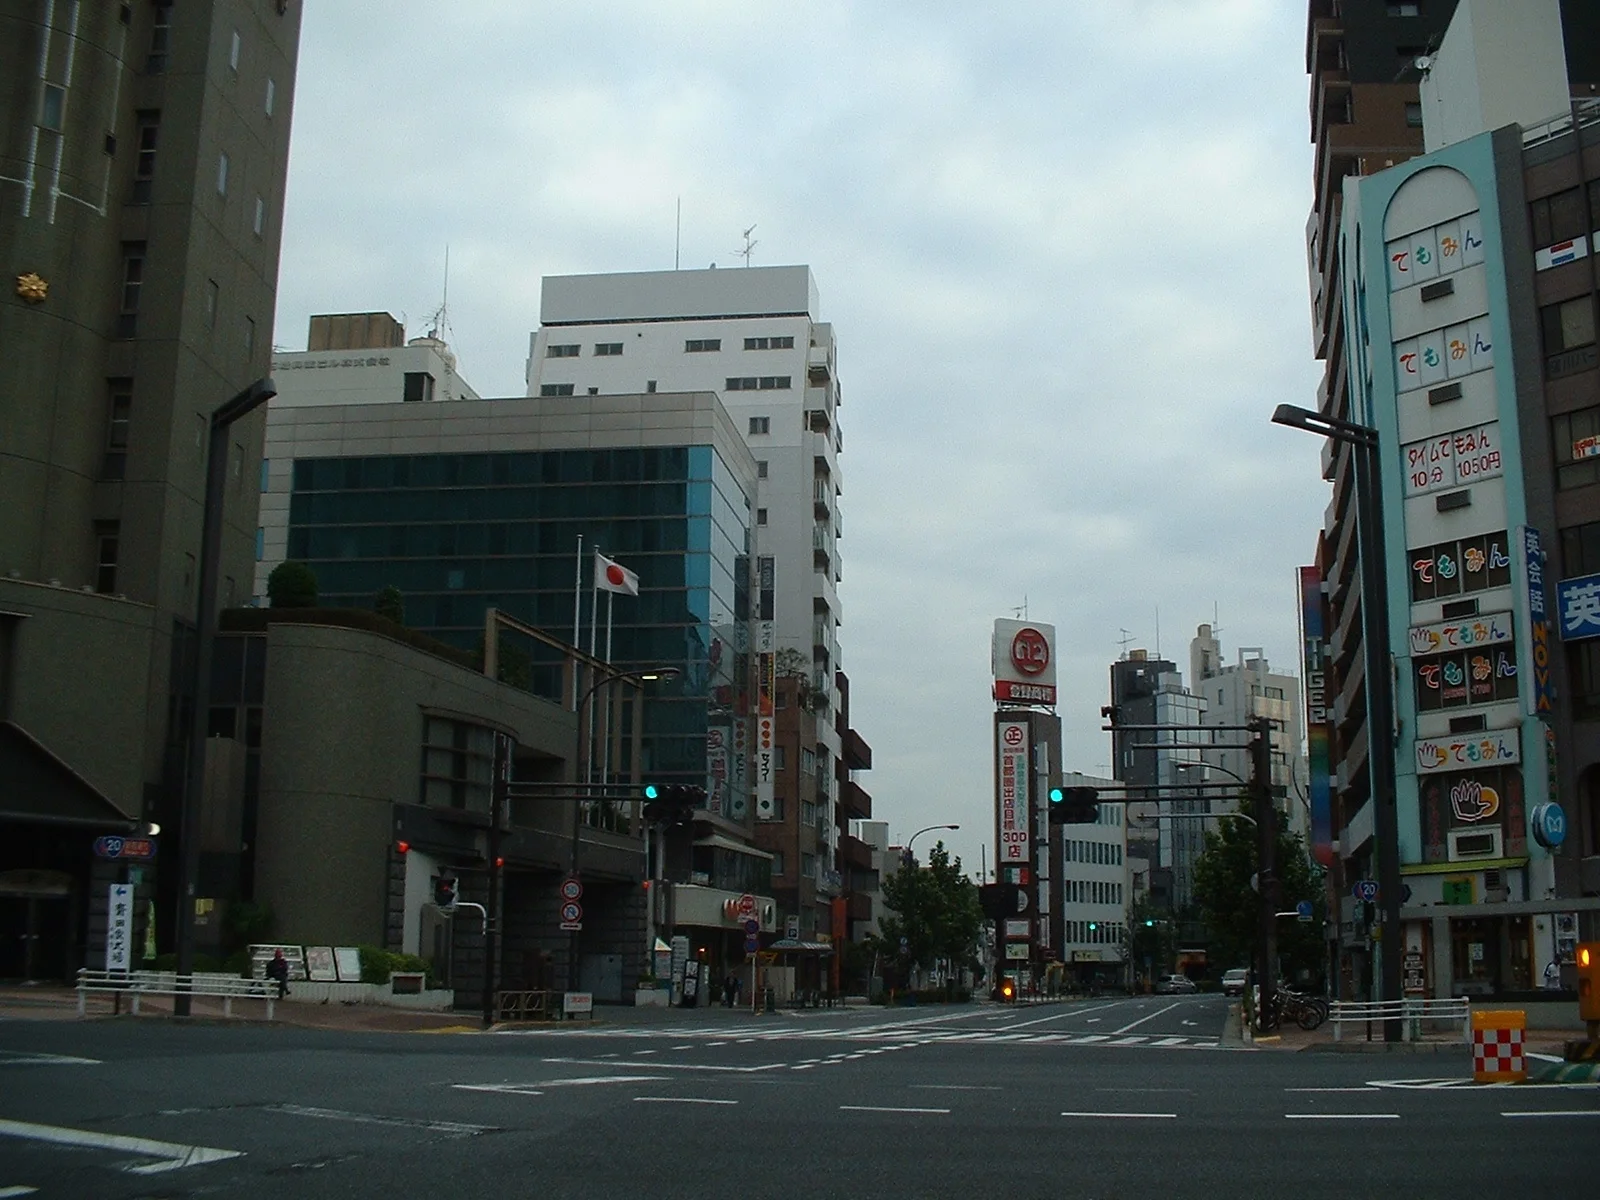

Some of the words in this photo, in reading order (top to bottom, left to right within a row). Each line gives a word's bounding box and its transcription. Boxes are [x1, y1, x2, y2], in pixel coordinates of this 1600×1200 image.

[1392, 230, 1482, 271] てもみん
[1400, 333, 1491, 373] てもみん
[1457, 452, 1501, 479] 1050円
[1413, 543, 1510, 583] てもみん
[1525, 531, 1545, 614] 英会話
[1443, 621, 1505, 645] てもみん
[1419, 651, 1517, 689] てもみん
[1533, 620, 1551, 712] NOVA
[1450, 739, 1513, 762] てもみん
[107, 839, 121, 852] 20
[1008, 845, 1021, 858] 店
[1363, 884, 1375, 895] 20
